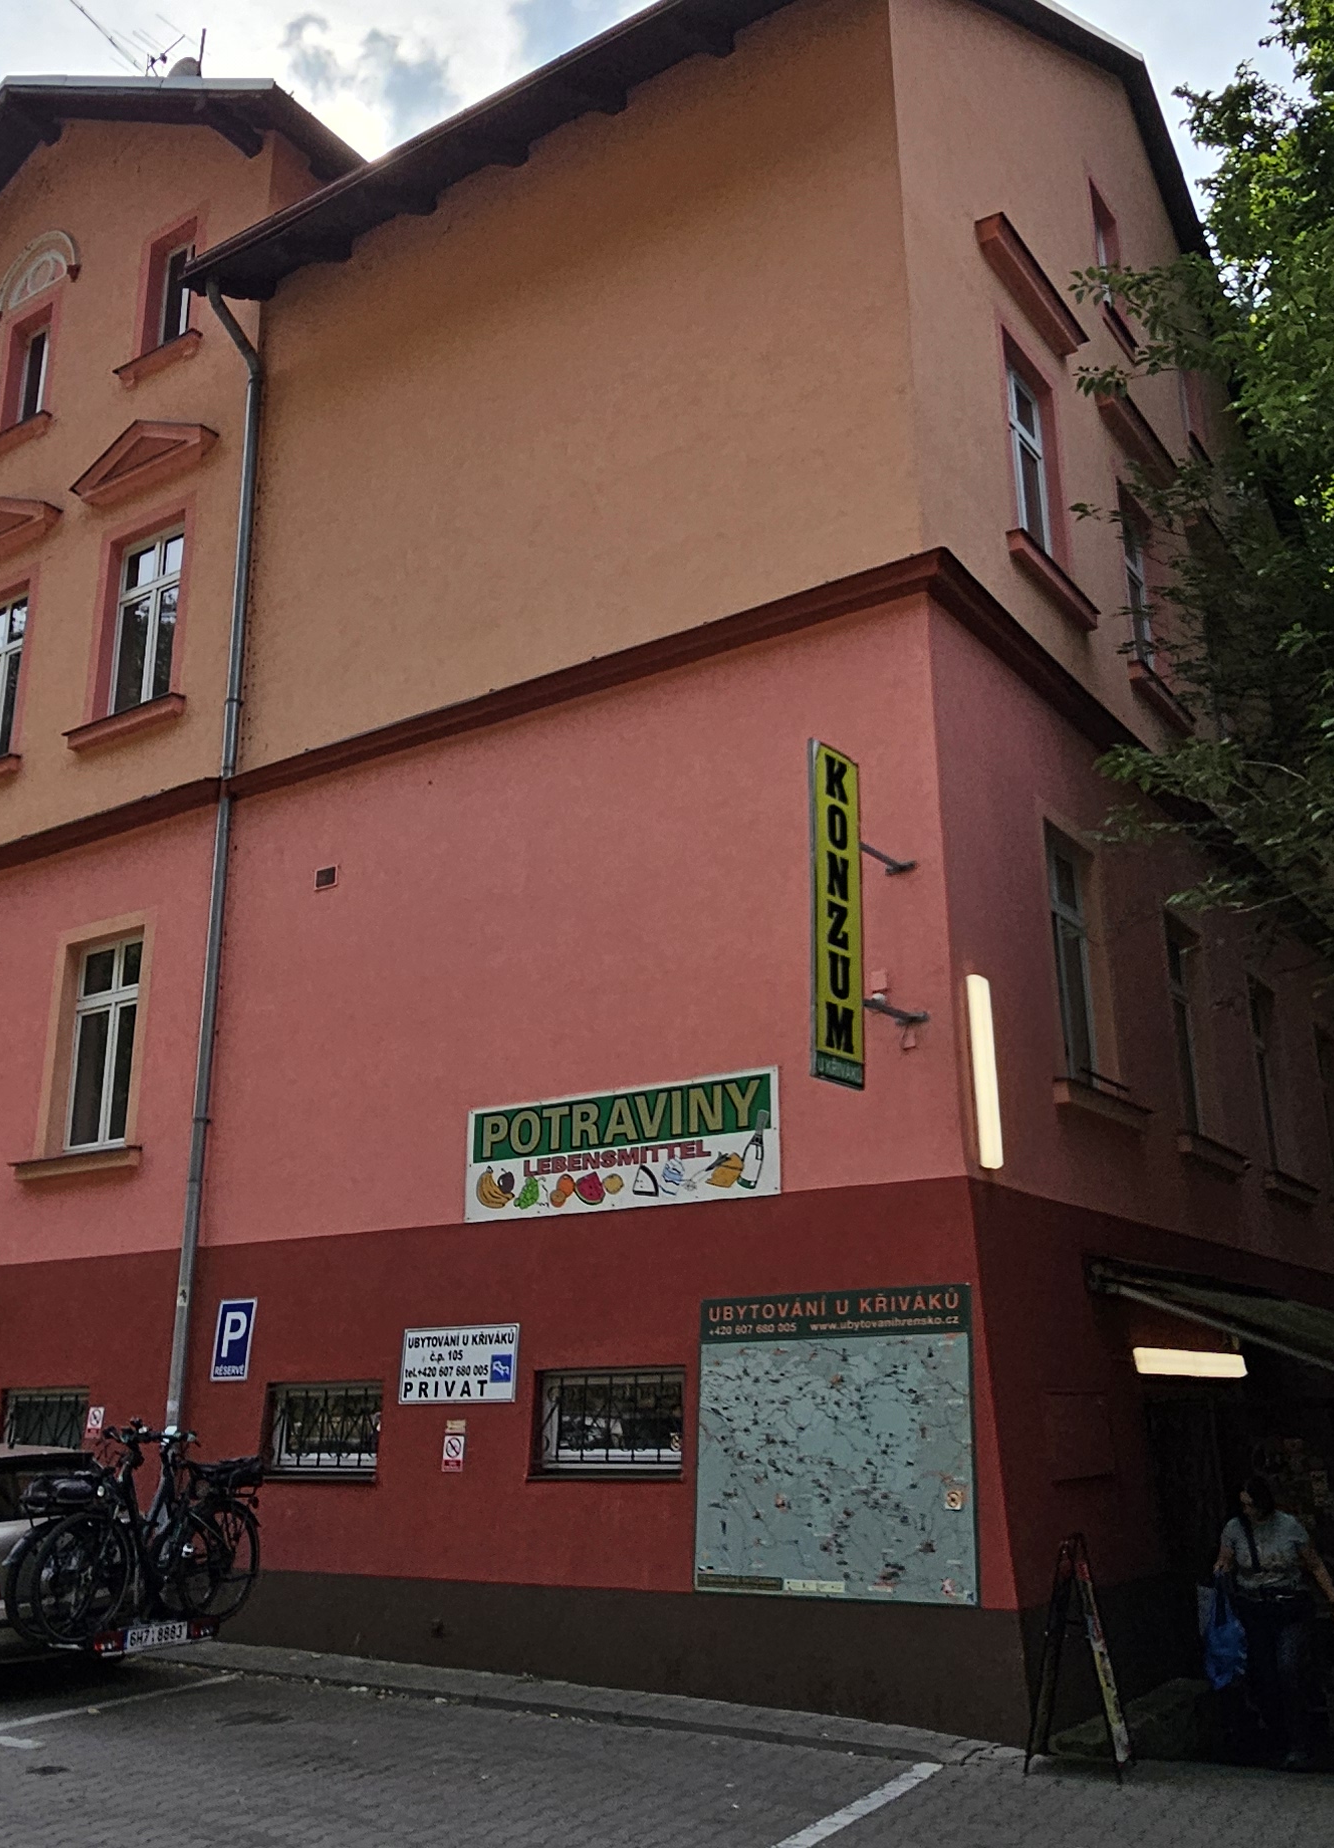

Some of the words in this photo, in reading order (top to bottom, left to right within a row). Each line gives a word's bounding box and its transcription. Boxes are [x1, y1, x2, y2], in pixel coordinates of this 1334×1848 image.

[824, 753, 855, 1055] KONZUM
[481, 1078, 762, 1159] POTRAVINY
[523, 1139, 712, 1178] LEBENSMITTEL
[708, 1295, 826, 1322] UBYTOVÁNÍ
[835, 1299, 850, 1315] U
[859, 1287, 960, 1314] KŘIVÁKŮ
[221, 1311, 247, 1358] P
[408, 1332, 460, 1349] UBYTOVÁNÍ
[462, 1334, 469, 1346] U
[471, 1329, 515, 1346] KŘIVÁKŮ
[709, 1325, 732, 1336] +420
[734, 1324, 753, 1335] 607
[777, 1322, 797, 1333] 005
[809, 1315, 960, 1332] www.ubytovanihrensko.cz
[448, 1350, 463, 1361] 105
[438, 1366, 454, 1377] 607
[456, 1365, 471, 1377] 680
[473, 1365, 489, 1376] 005
[403, 1380, 488, 1399] PRIVAT
